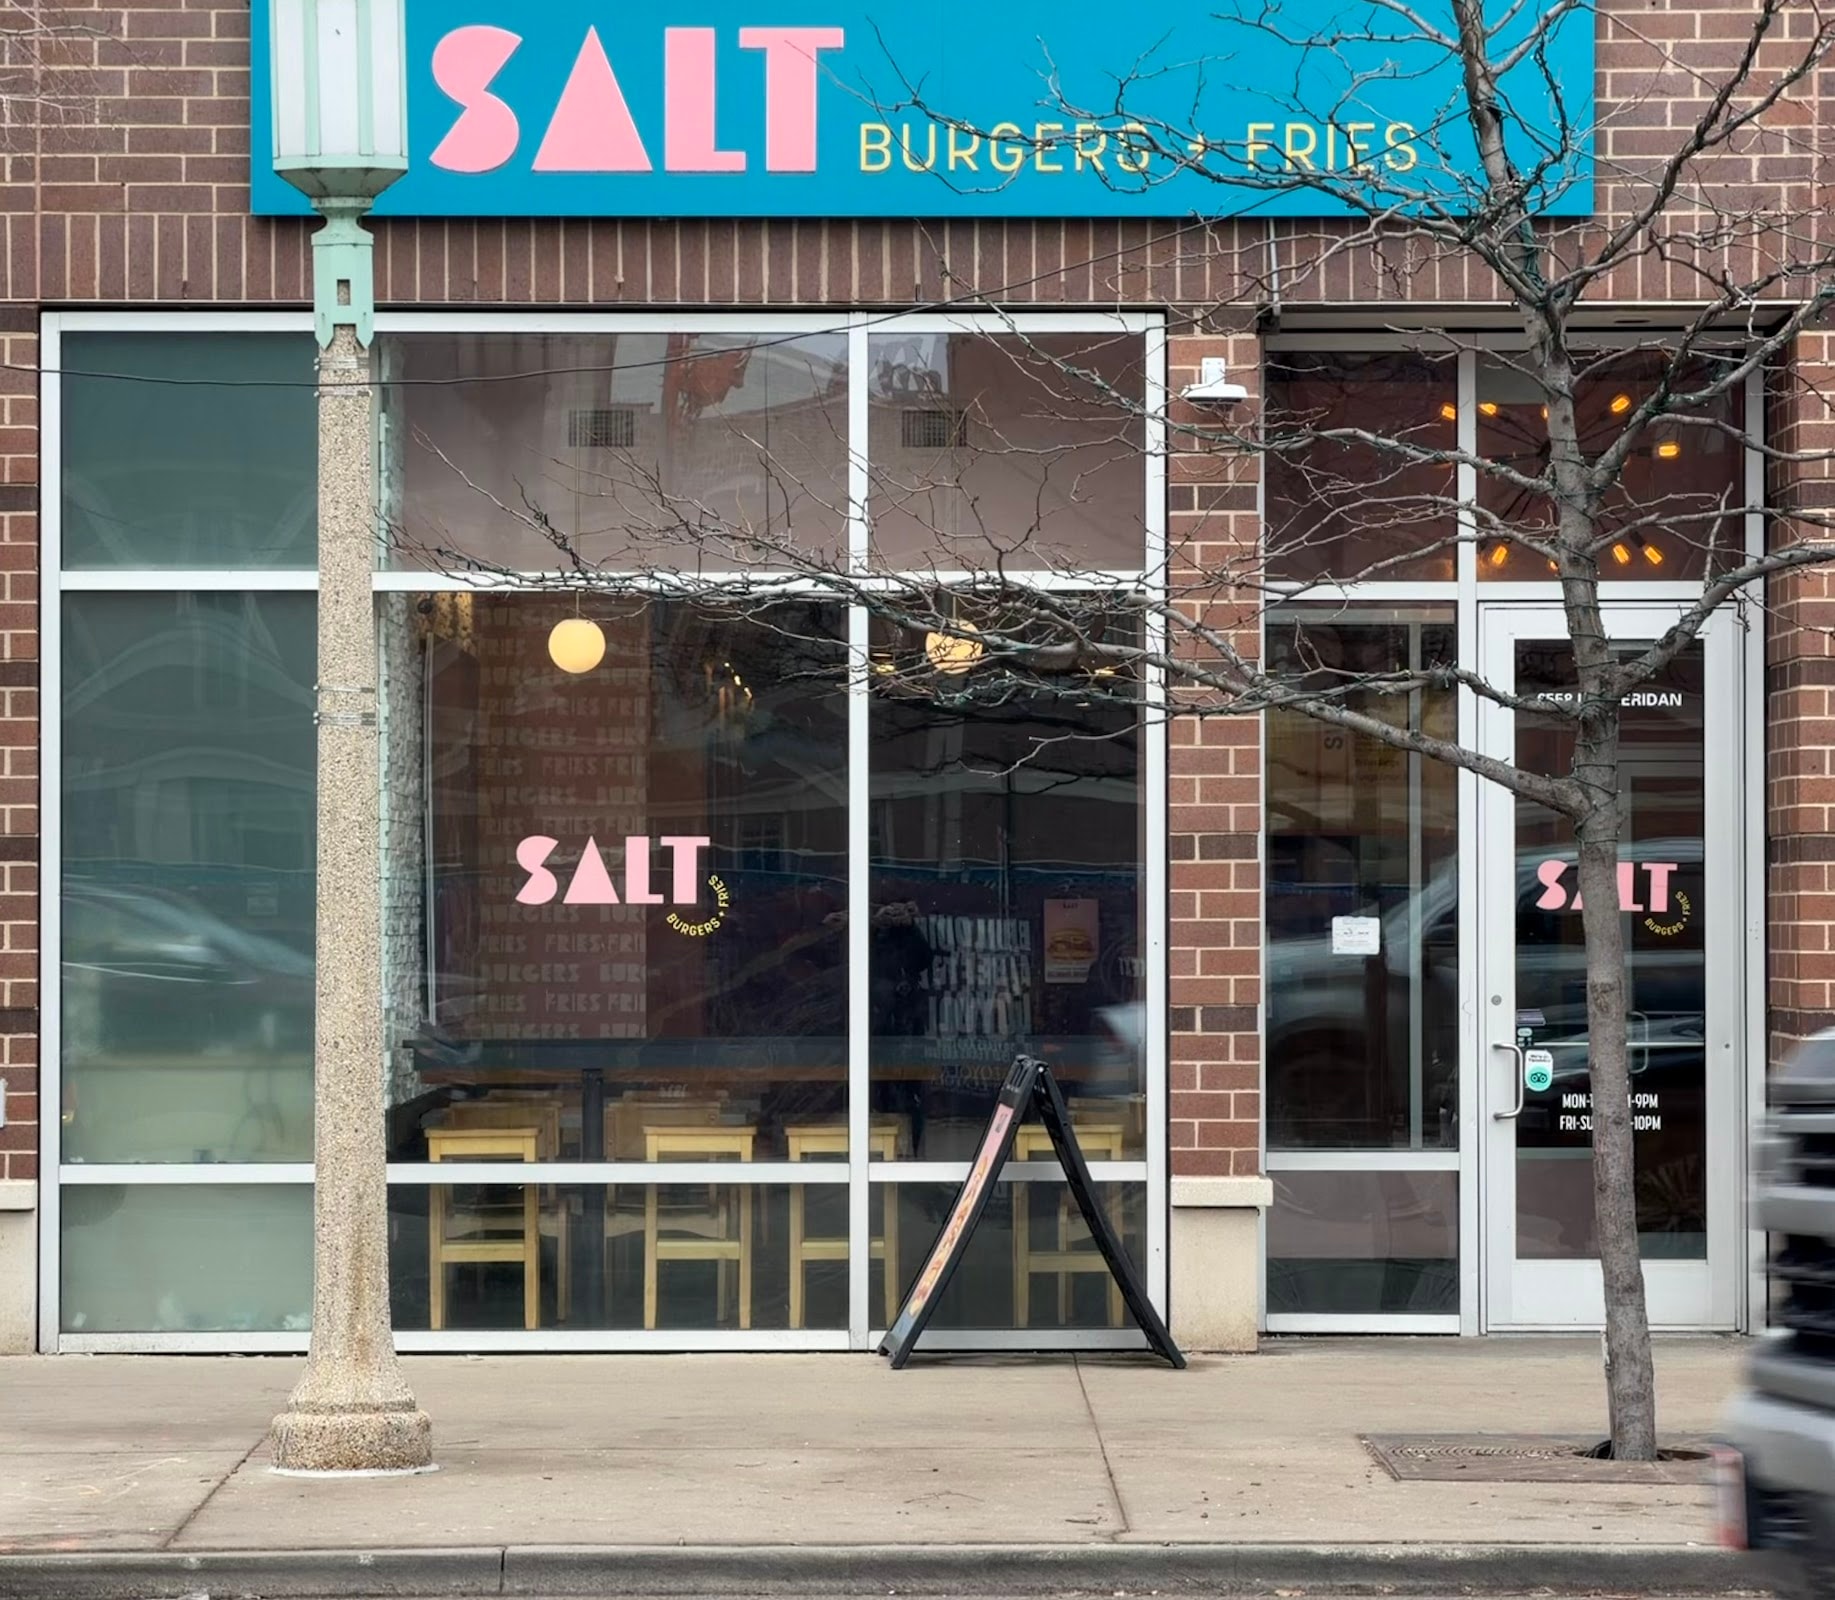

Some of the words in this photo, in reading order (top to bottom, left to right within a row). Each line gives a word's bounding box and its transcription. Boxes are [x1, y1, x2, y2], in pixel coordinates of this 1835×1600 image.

[428, 25, 845, 172] SALT
[859, 123, 1150, 172] BURGERS
[1247, 123, 1418, 172] FRIES
[1620, 692, 1683, 706] ERIDAN
[515, 835, 711, 905] SALT
[1535, 859, 1679, 913] SLT
[666, 912, 721, 936] BURGERS
[708, 875, 729, 908] FRIES
[1644, 917, 1685, 936] BURGERS
[1675, 891, 1692, 916] FRIES
[1559, 1115, 1594, 1131] FRI-SU
[1562, 1093, 1594, 1109] MON-T
